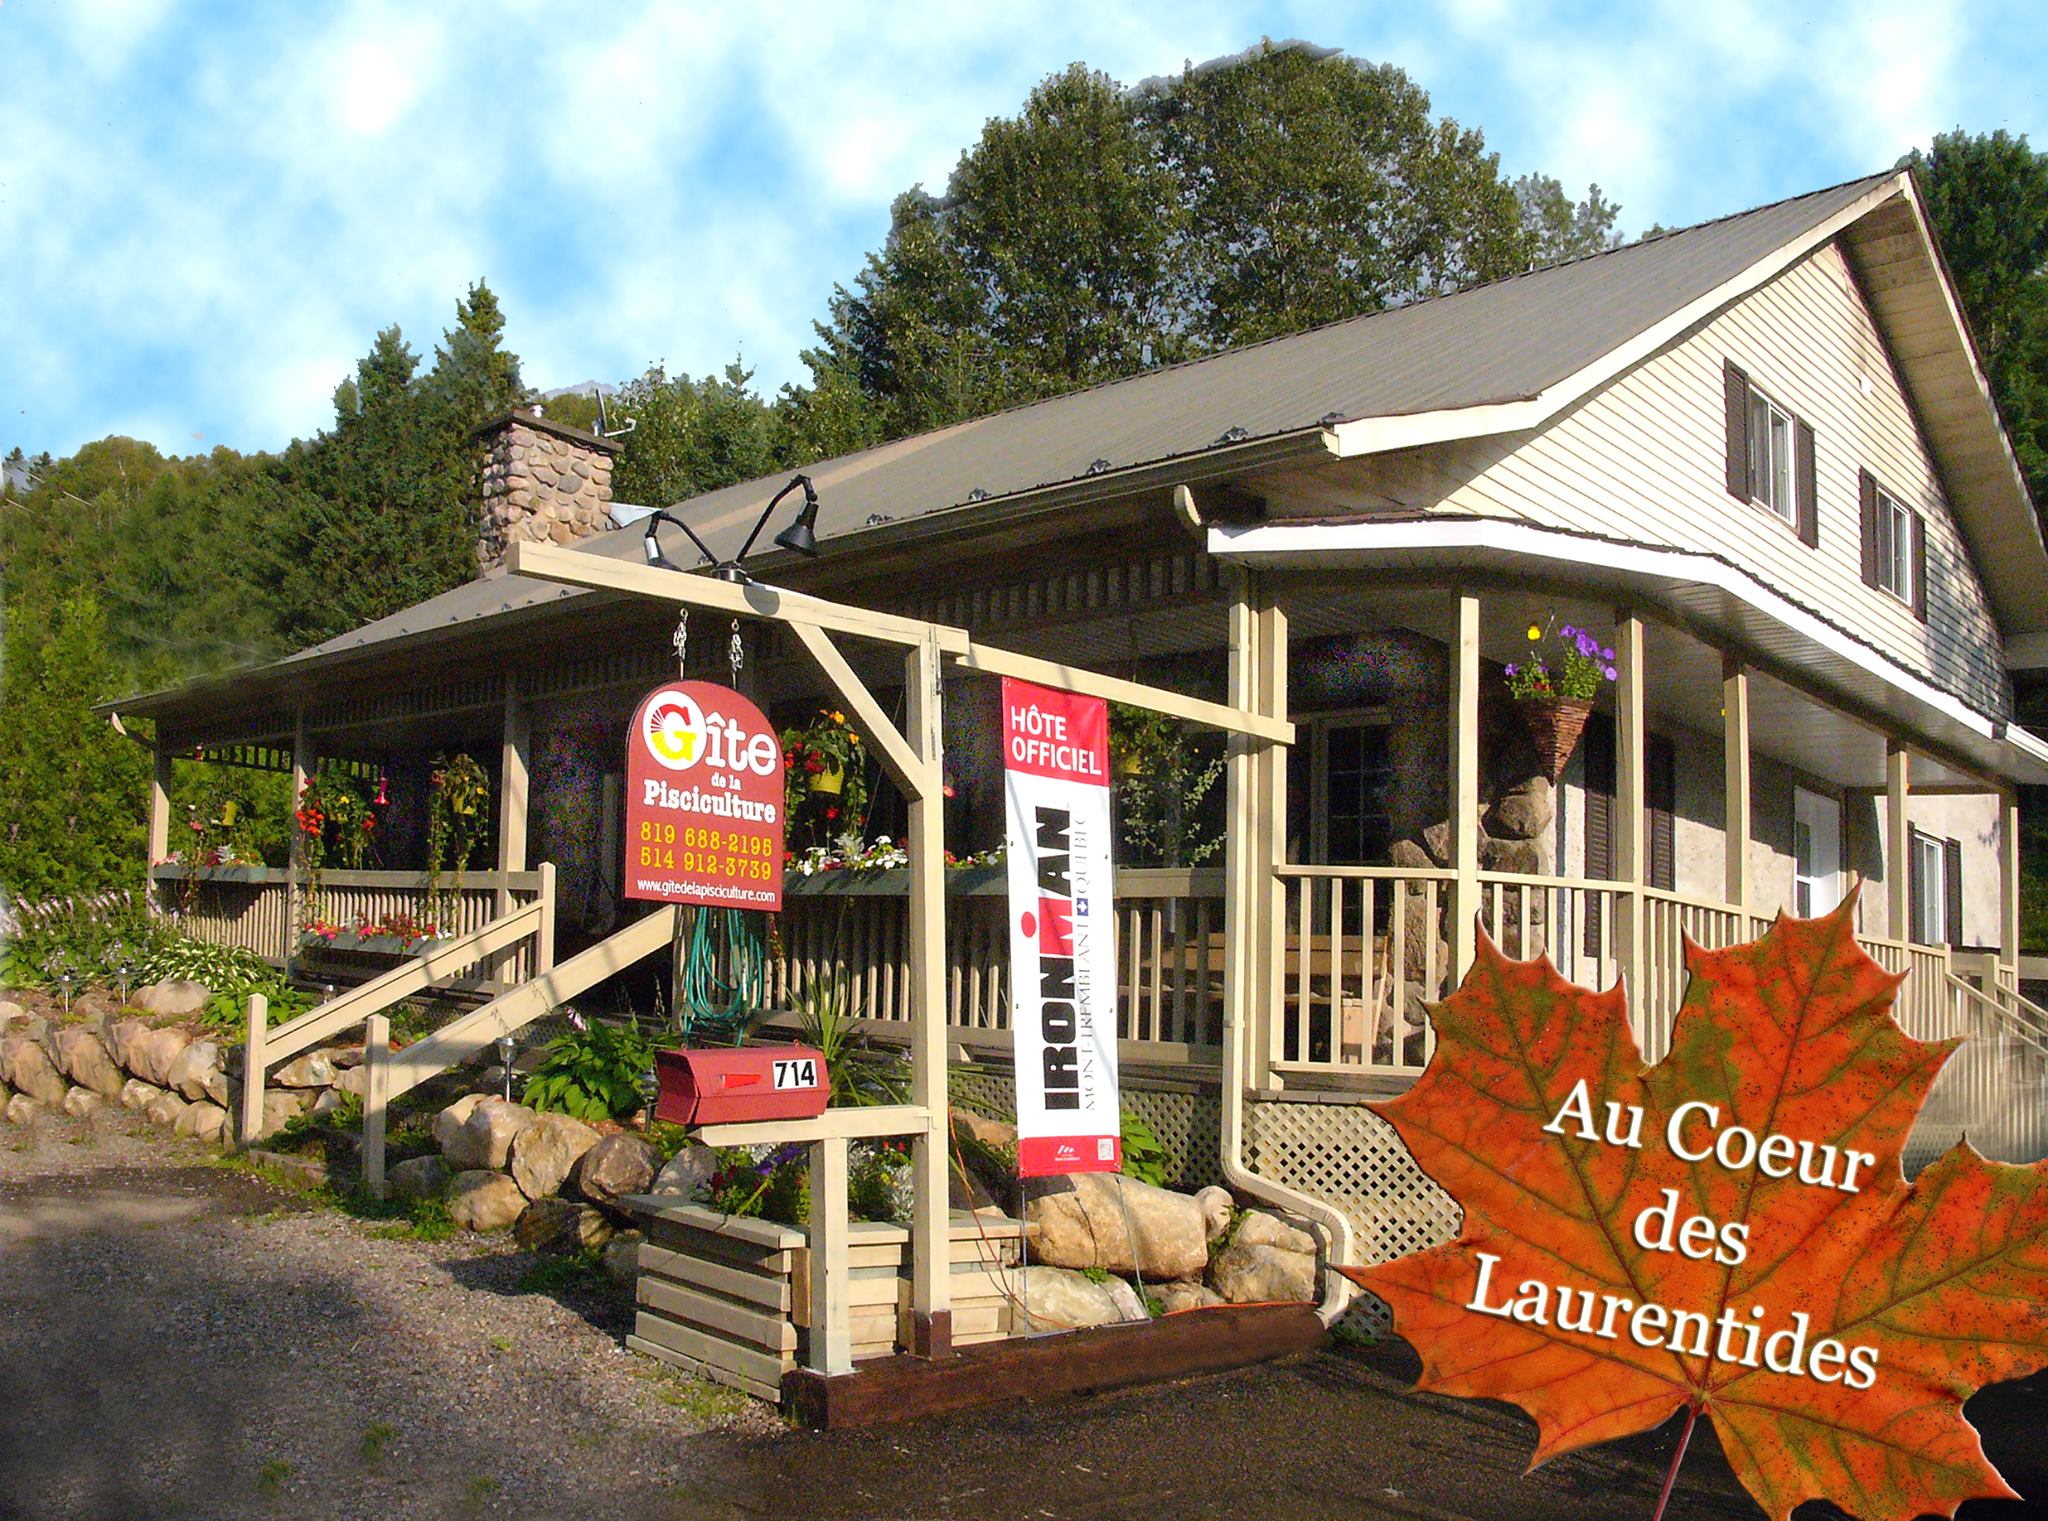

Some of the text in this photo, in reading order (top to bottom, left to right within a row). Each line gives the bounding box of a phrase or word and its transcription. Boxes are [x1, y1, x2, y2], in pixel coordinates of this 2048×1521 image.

[650, 702, 777, 776] Gîte
[1011, 704, 1067, 742] HÔTE
[1012, 736, 1102, 775] OFFICIEL
[711, 772, 741, 791] de la
[643, 778, 776, 824] Pisciculture
[640, 821, 773, 856] 819 688-2195
[640, 846, 771, 880] 514 912-3739
[637, 878, 776, 903] www.gitedelapisciculture.com
[1035, 805, 1080, 1110] IRONMAN
[775, 1061, 815, 1088] 714
